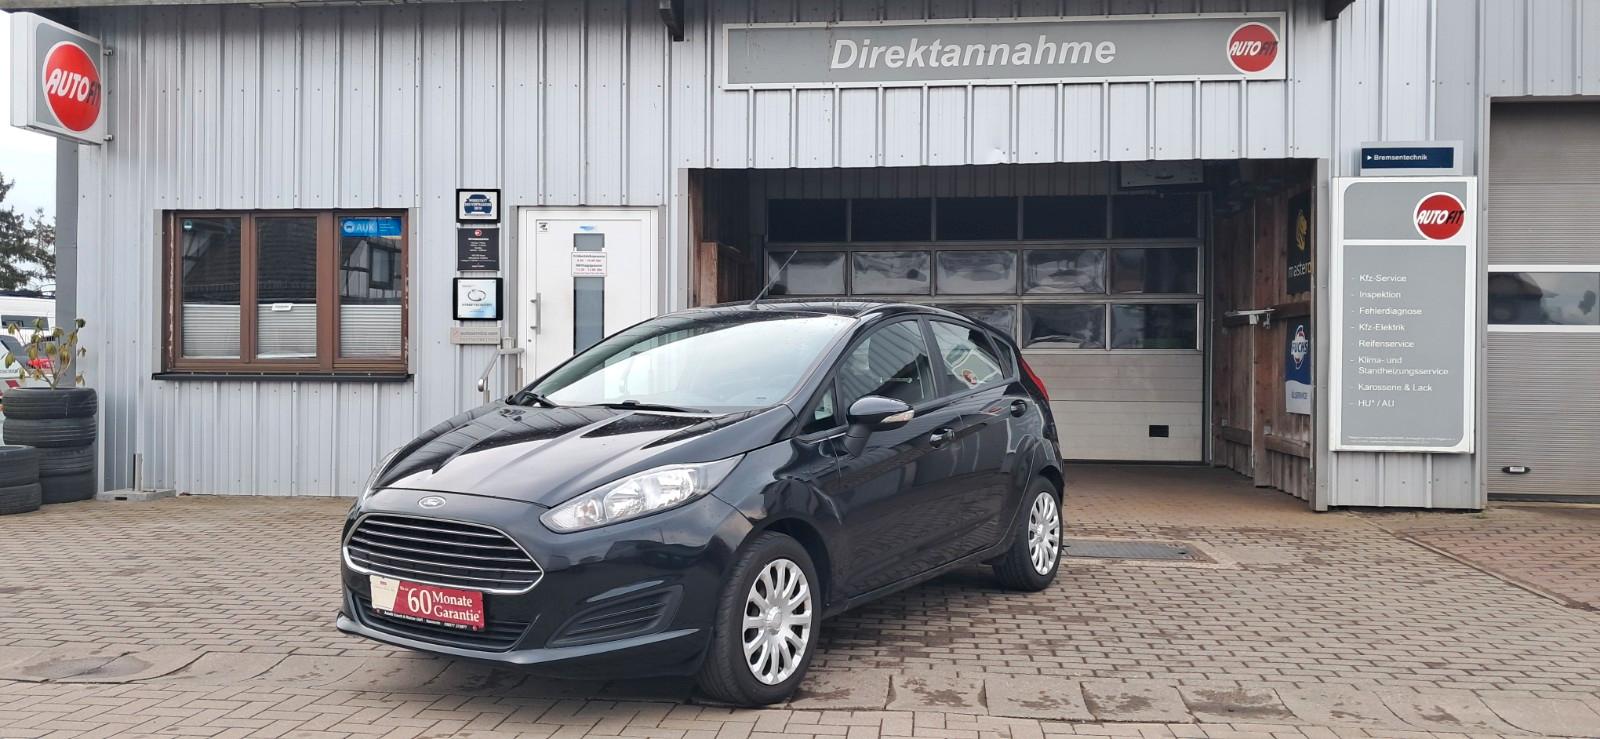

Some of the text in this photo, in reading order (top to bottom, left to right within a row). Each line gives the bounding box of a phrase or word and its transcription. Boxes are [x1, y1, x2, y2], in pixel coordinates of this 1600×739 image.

[831, 35, 1116, 69] Direktannahme
[1416, 209, 1464, 225] AUTOFIT
[355, 223, 376, 233] AUK
[1359, 274, 1407, 282] Kfz-Service
[1359, 291, 1401, 299] Inspektion
[1359, 307, 1423, 316] Fehlerdiagnose
[1359, 323, 1405, 332] Kfz-Elektrik
[1290, 340, 1309, 354] FUCHS
[1358, 339, 1415, 348] Reifenservice
[1358, 356, 1402, 364] Klima- und
[1358, 366, 1449, 376] Standheizungsservice
[1358, 384, 1433, 392] Karosserie & Lack
[407, 587, 432, 614] 60
[432, 590, 473, 607] Monate
